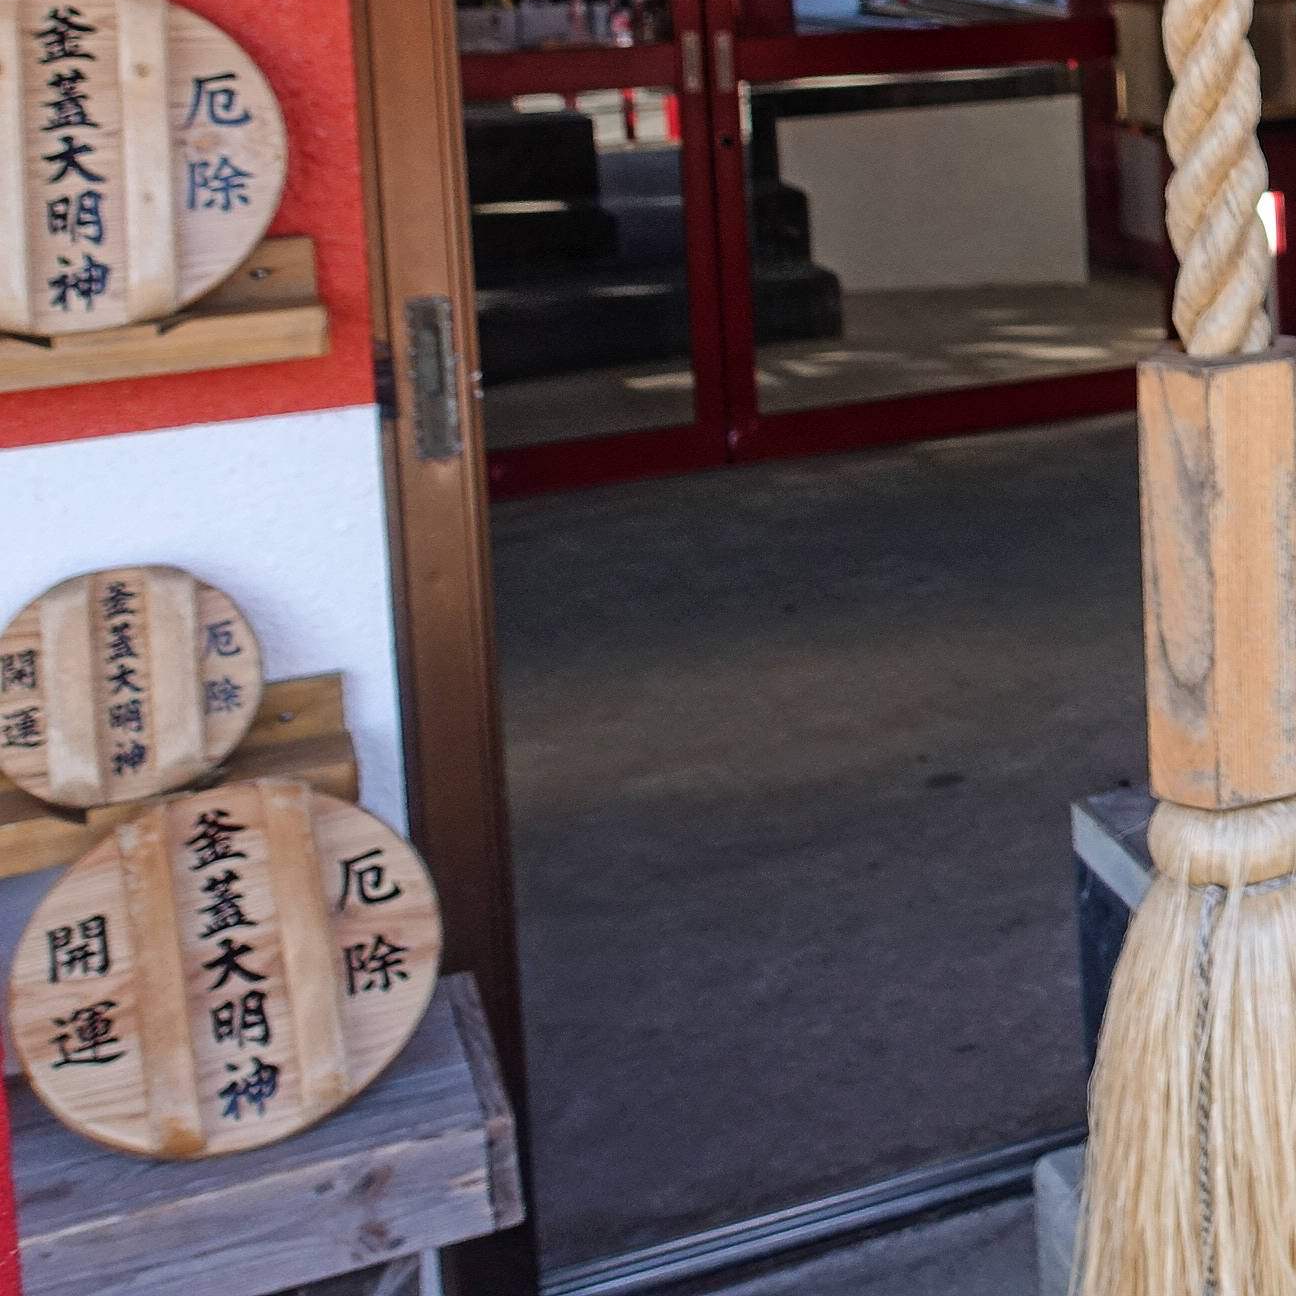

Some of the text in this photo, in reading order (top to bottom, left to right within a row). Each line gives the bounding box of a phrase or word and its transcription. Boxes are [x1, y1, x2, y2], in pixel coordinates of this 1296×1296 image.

[33, 5, 111, 313] 釜蓋大明神
[184, 72, 254, 212] 厄除
[0, 648, 42, 748] 開運
[103, 580, 147, 777] 釜蓋大明神
[206, 619, 243, 715] 厄除
[46, 914, 128, 1070] 開運
[186, 809, 282, 1120] 釜蓋大明神
[334, 847, 411, 998] 厄除
